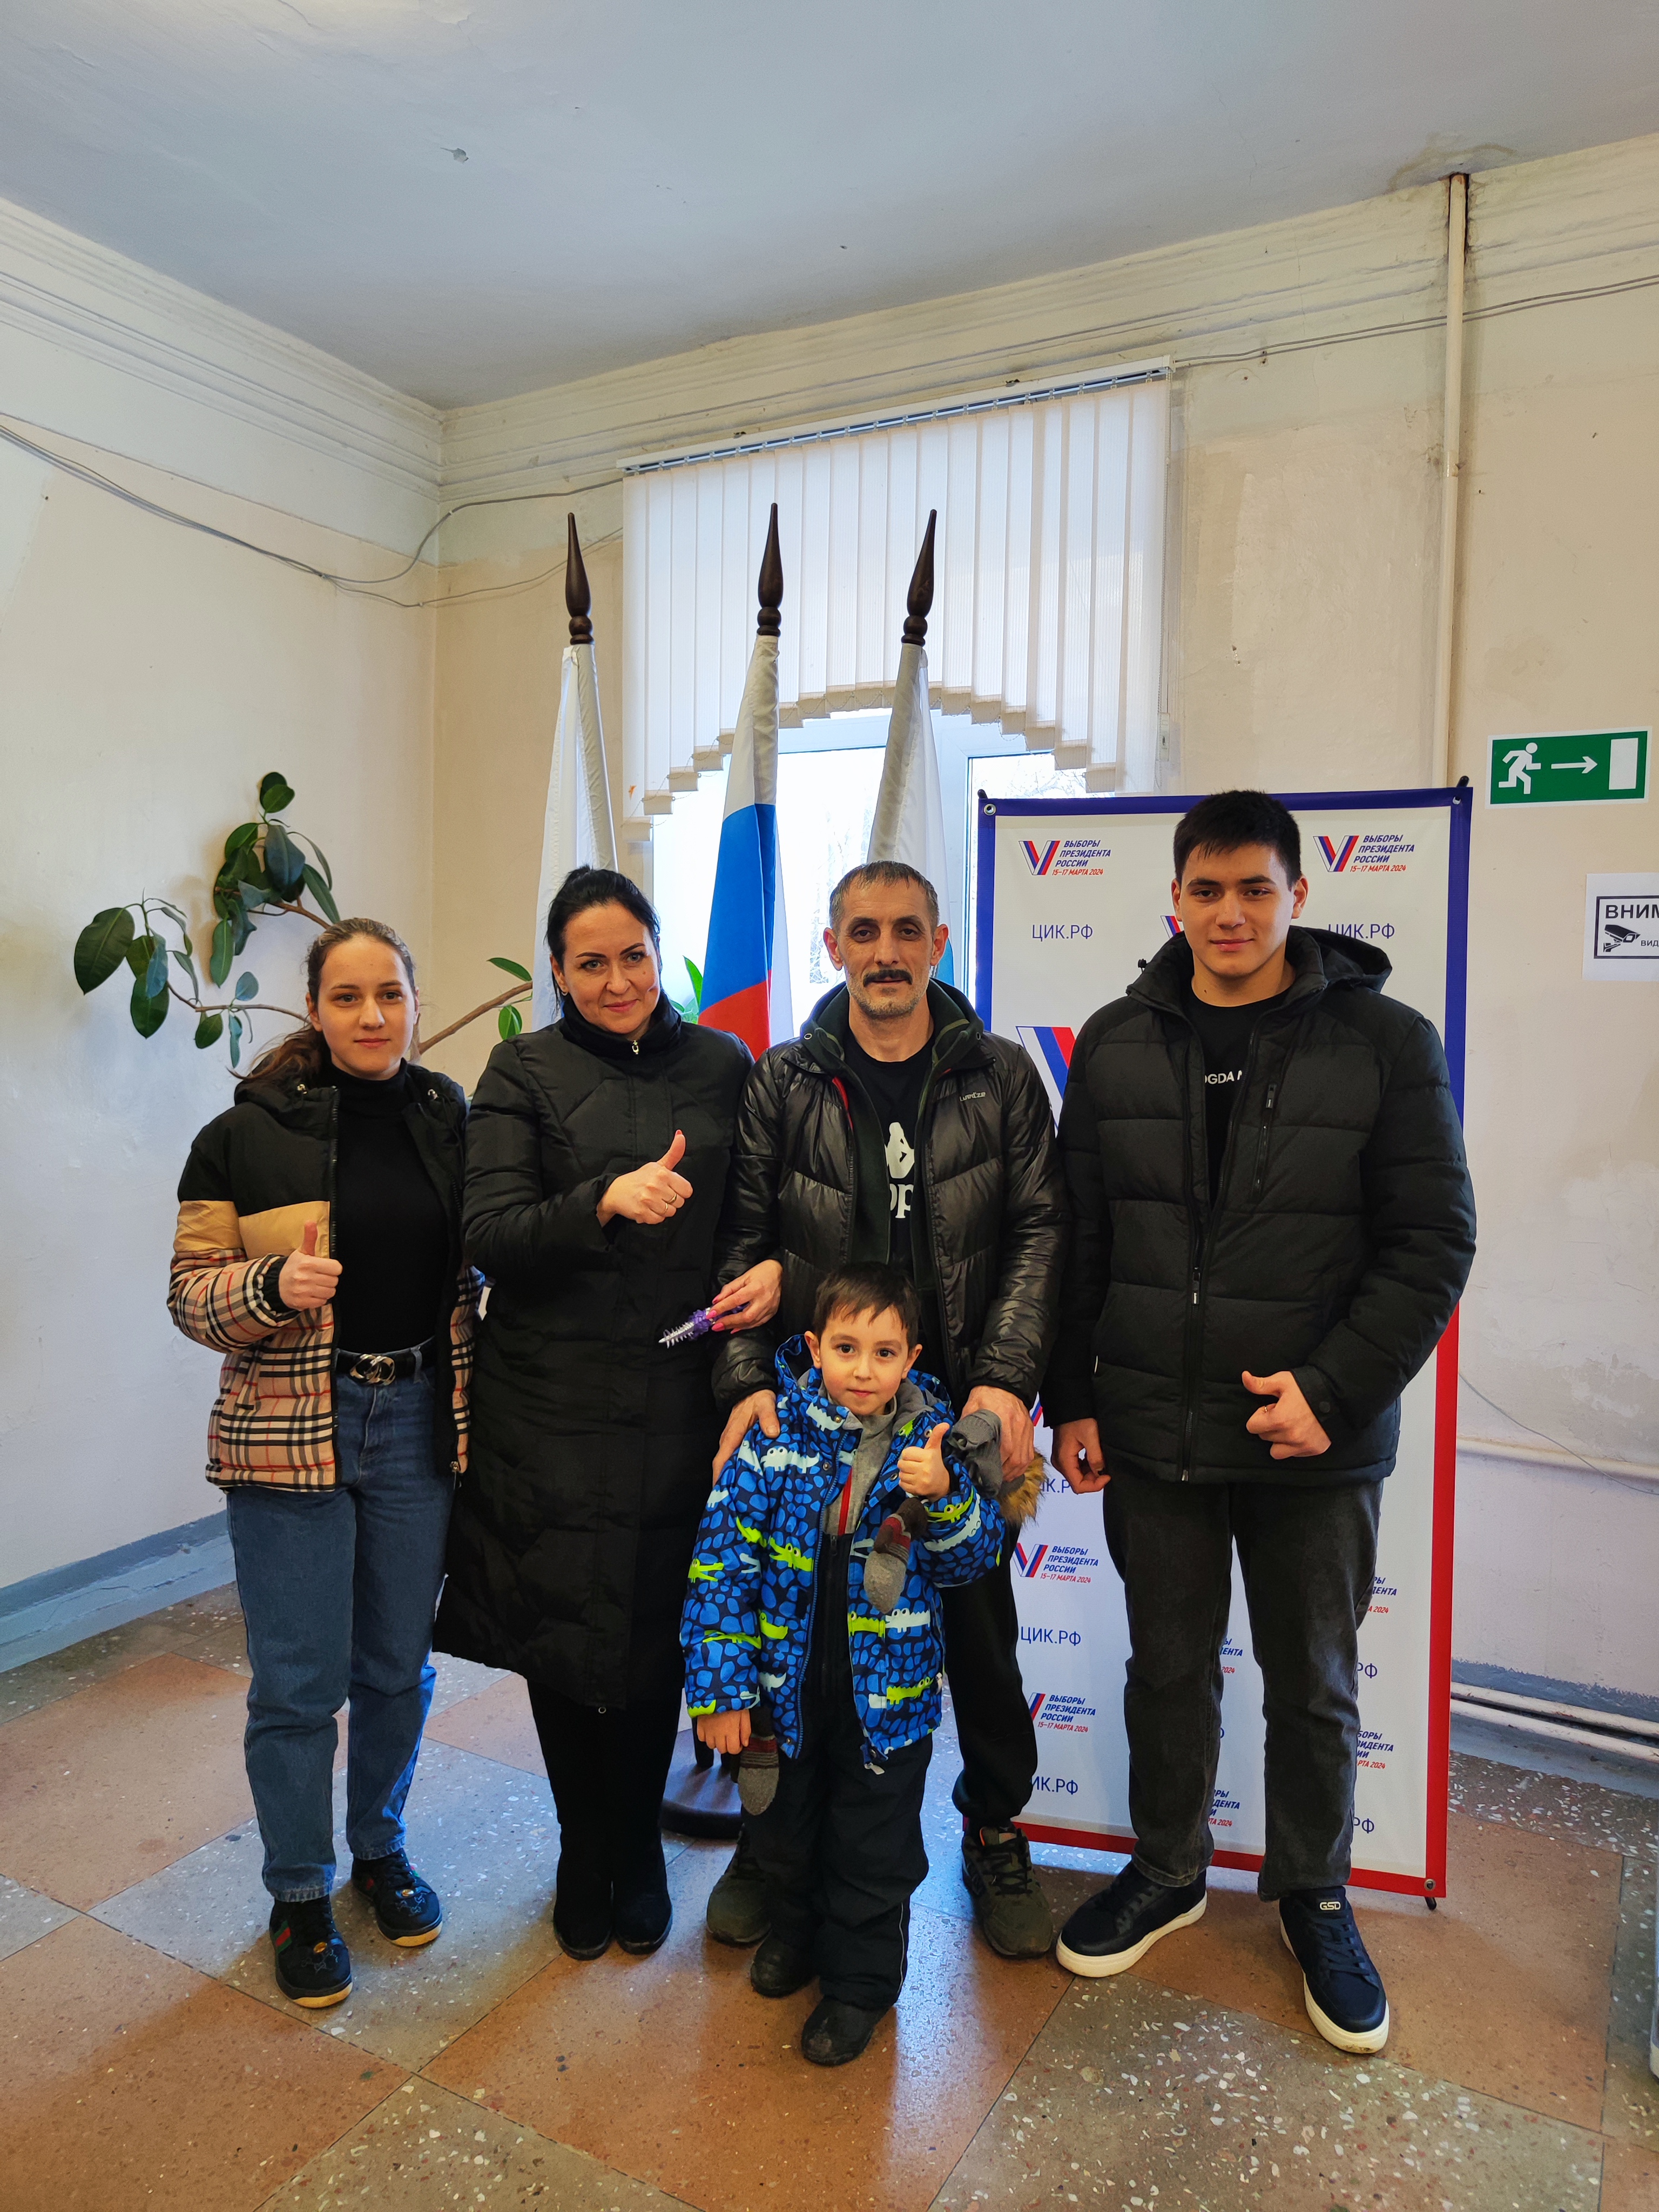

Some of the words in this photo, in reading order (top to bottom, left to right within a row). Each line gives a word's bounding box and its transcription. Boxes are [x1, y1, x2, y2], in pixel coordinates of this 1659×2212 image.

[1363, 834, 1404, 842] ВЫБОРЫ
[1060, 849, 1111, 858] ПРЕЗИДЕНТА
[1358, 845, 1415, 853] ПРЕЗИДЕНТА
[1032, 924, 1093, 942] ЦИК.РФ
[1051, 1546, 1088, 1556] ВЫБОРЫ
[1048, 1555, 1099, 1566] ПРЕЗИДЕНТА
[1043, 1564, 1076, 1574] РОССИИ
[1021, 1626, 1081, 1646] ЦИК.РФ
[1049, 1695, 1085, 1705] ВЫБОРЫ
[1044, 1703, 1096, 1716] ПРЕЗИДЕНТА
[1041, 1712, 1074, 1722] РОССИИ
[1054, 1723, 1074, 1731] МАРТА
[1031, 1776, 1078, 1795] ИК.РФ
[1319, 1901, 1341, 1910] GSD
